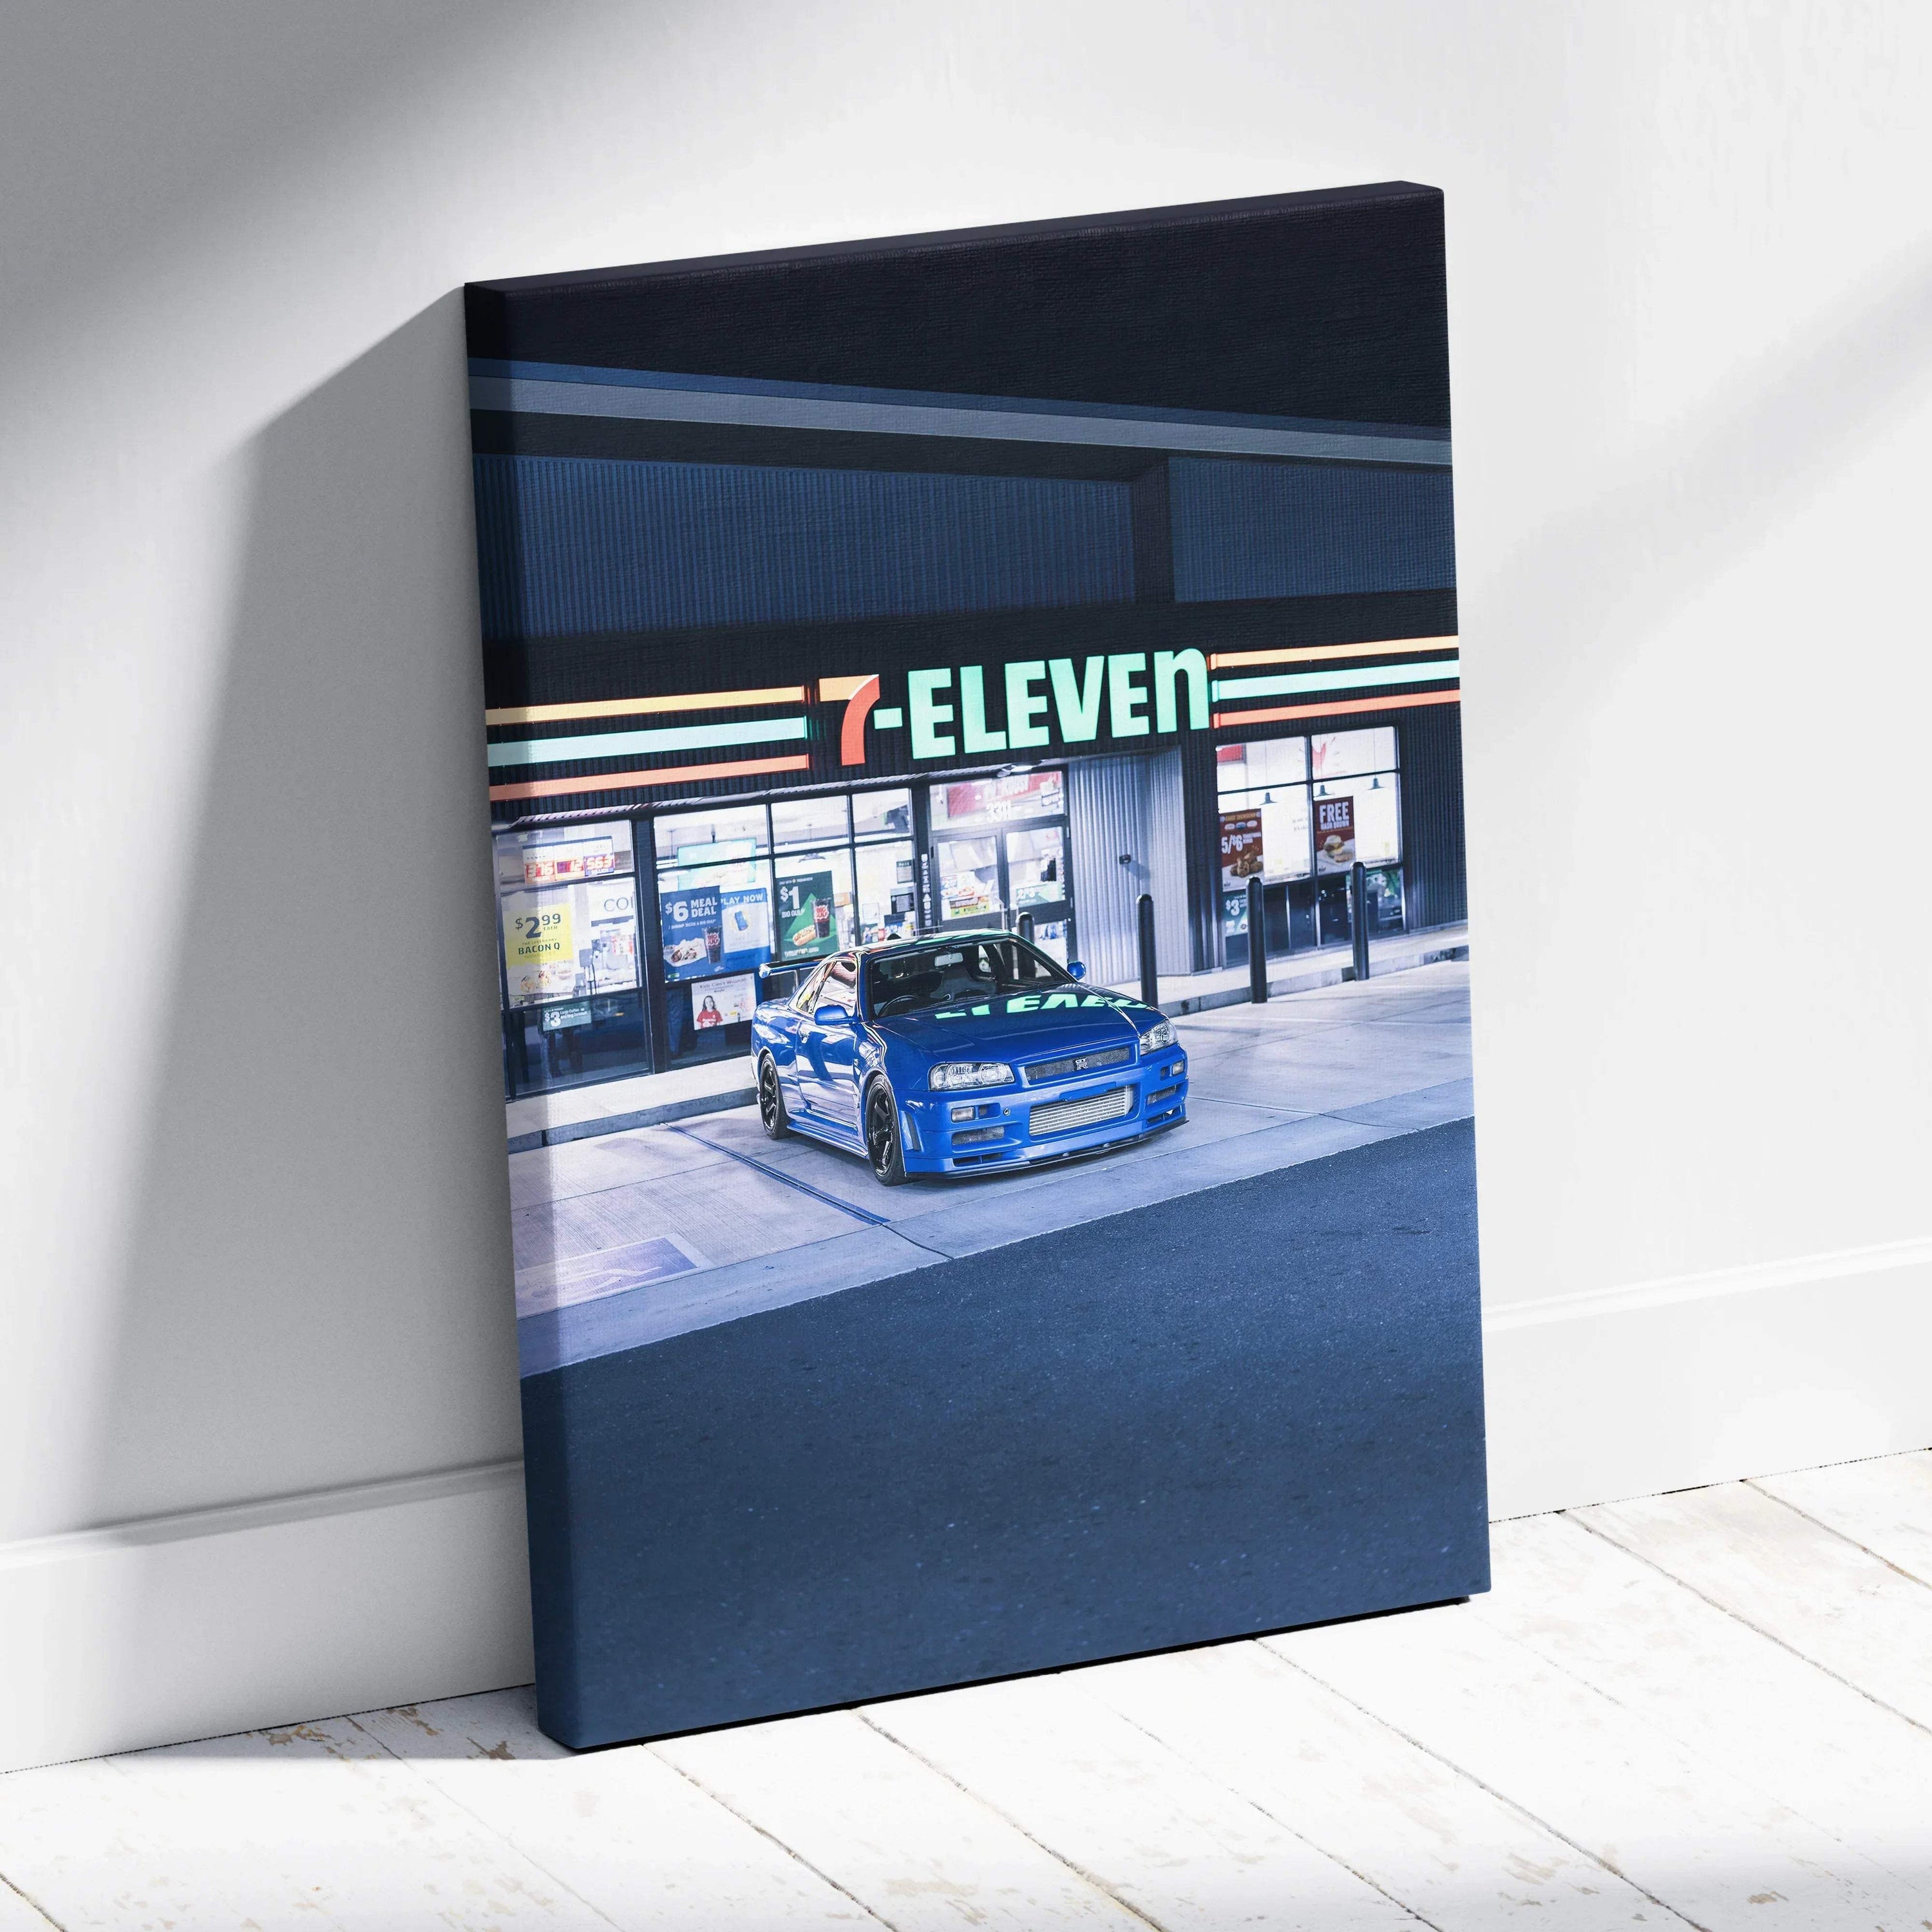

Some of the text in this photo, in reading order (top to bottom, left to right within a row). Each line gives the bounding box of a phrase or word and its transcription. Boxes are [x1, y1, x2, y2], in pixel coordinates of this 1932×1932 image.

[1319, 801, 1350, 824] FREE
[690, 896, 718, 909] MEAL
[743, 893, 763, 902] NOW
[780, 886, 799, 909] $1
[665, 900, 689, 922] $6
[691, 906, 717, 918] DEAL
[782, 910, 791, 918] BIG
[1226, 899, 1240, 916] $3
[518, 943, 551, 954] BACON
[554, 942, 560, 951] Q
[544, 1012, 561, 1027] $3
